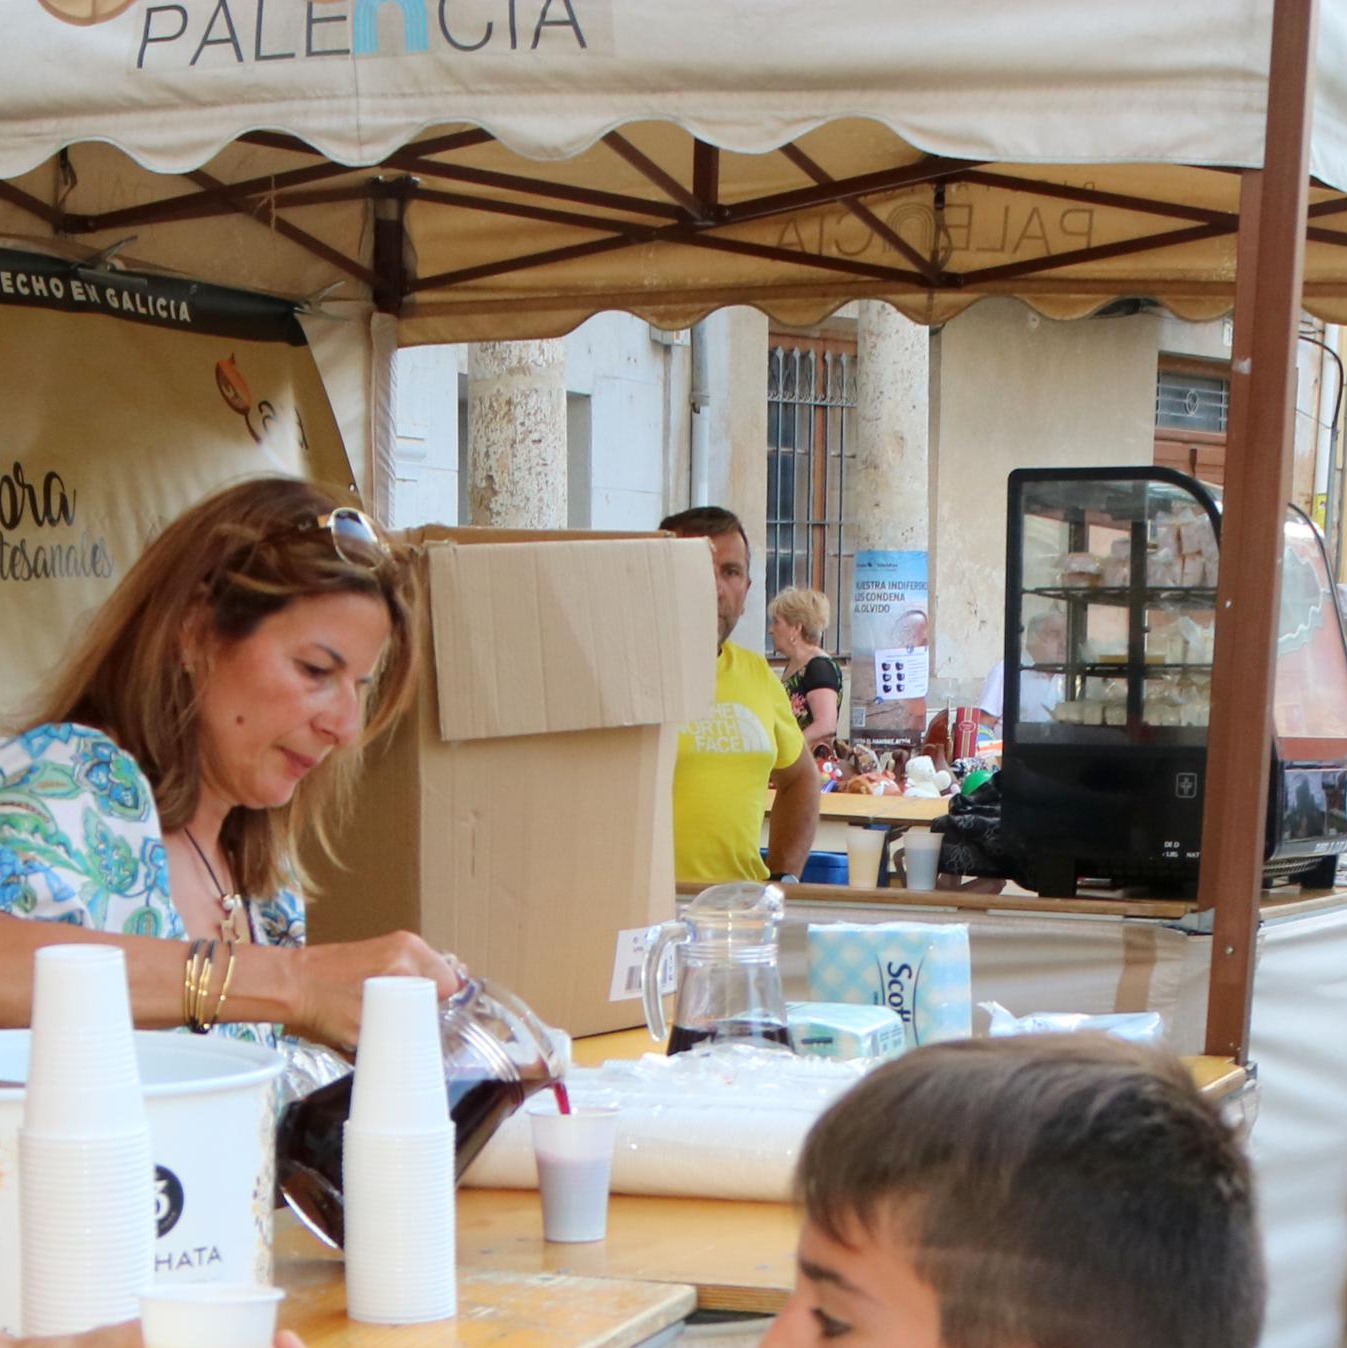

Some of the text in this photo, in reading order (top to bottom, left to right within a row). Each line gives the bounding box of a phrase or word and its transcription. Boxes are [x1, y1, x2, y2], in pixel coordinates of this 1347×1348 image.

[71, 280, 101, 303] EN
[106, 287, 192, 323] GALICIA
[866, 592, 906, 601] CONDENA
[154, 1246, 222, 1272] HATA
